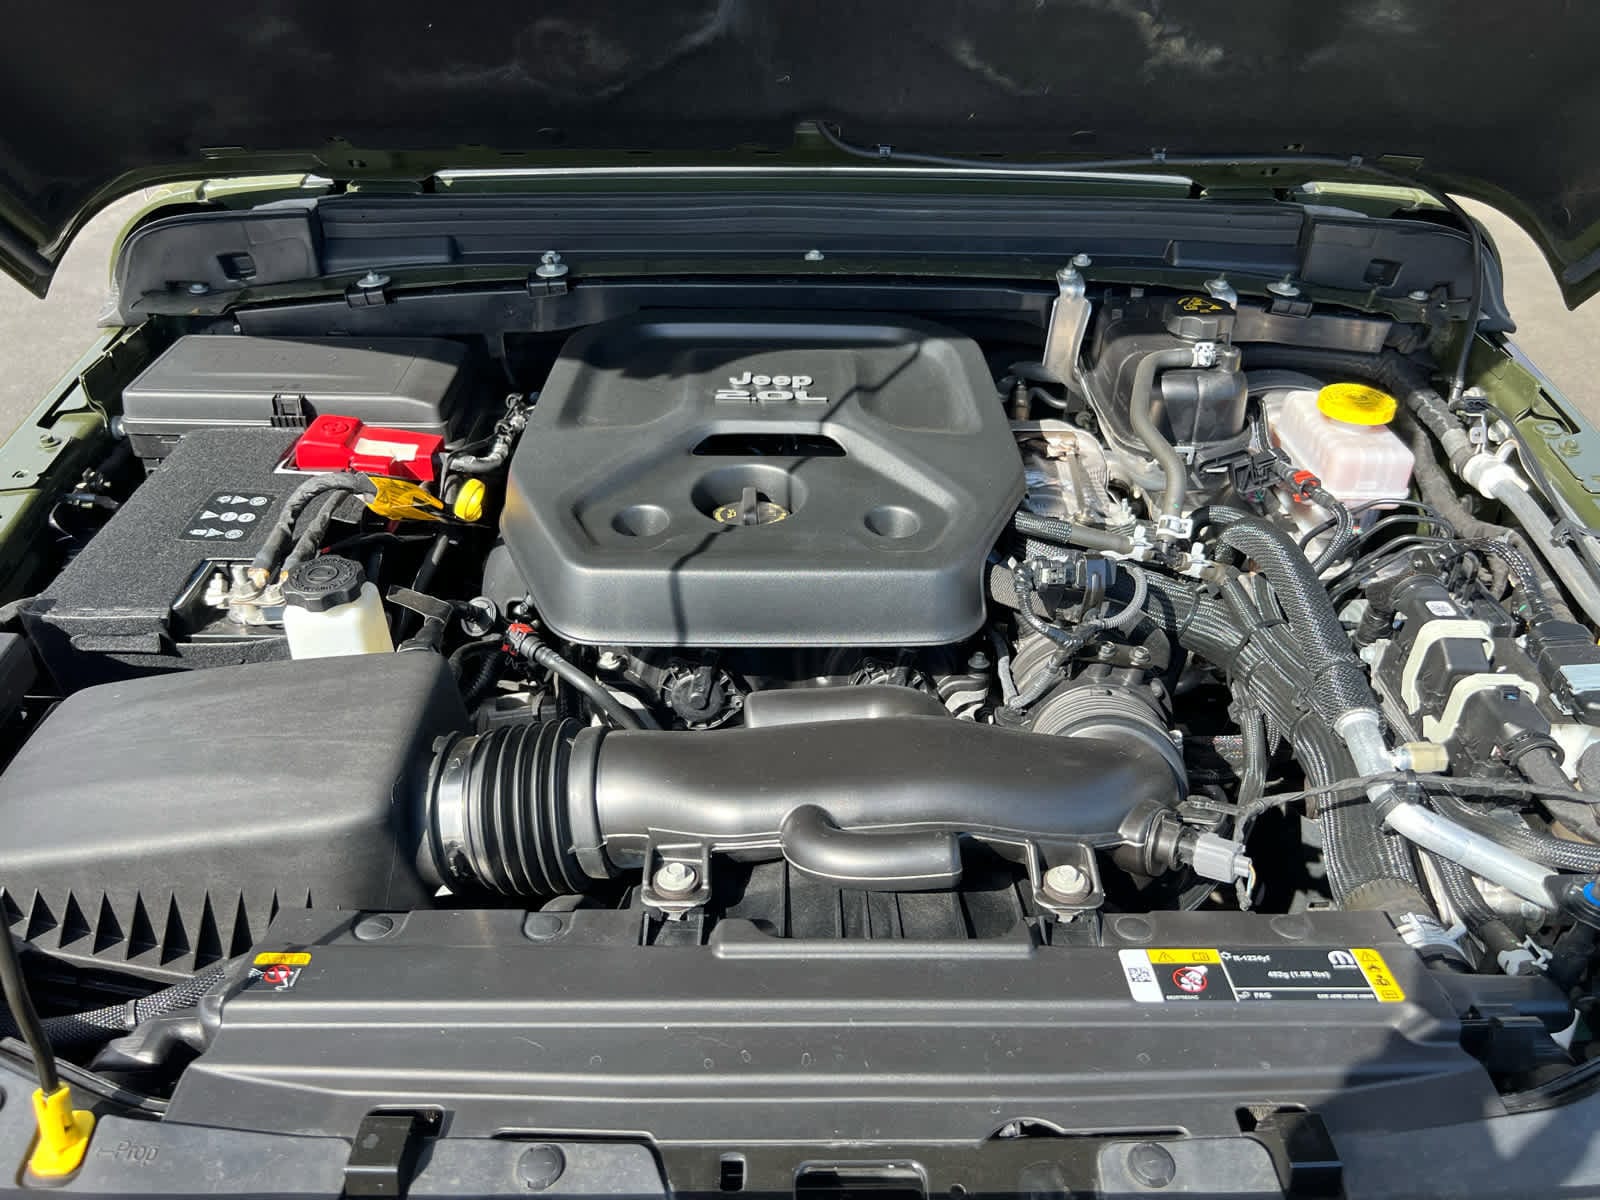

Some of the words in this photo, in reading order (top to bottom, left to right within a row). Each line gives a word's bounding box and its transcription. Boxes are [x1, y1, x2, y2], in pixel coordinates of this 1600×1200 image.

[729, 371, 813, 388] Jeep
[715, 389, 828, 401] 2.0L
[115, 1140, 160, 1168] Prop
